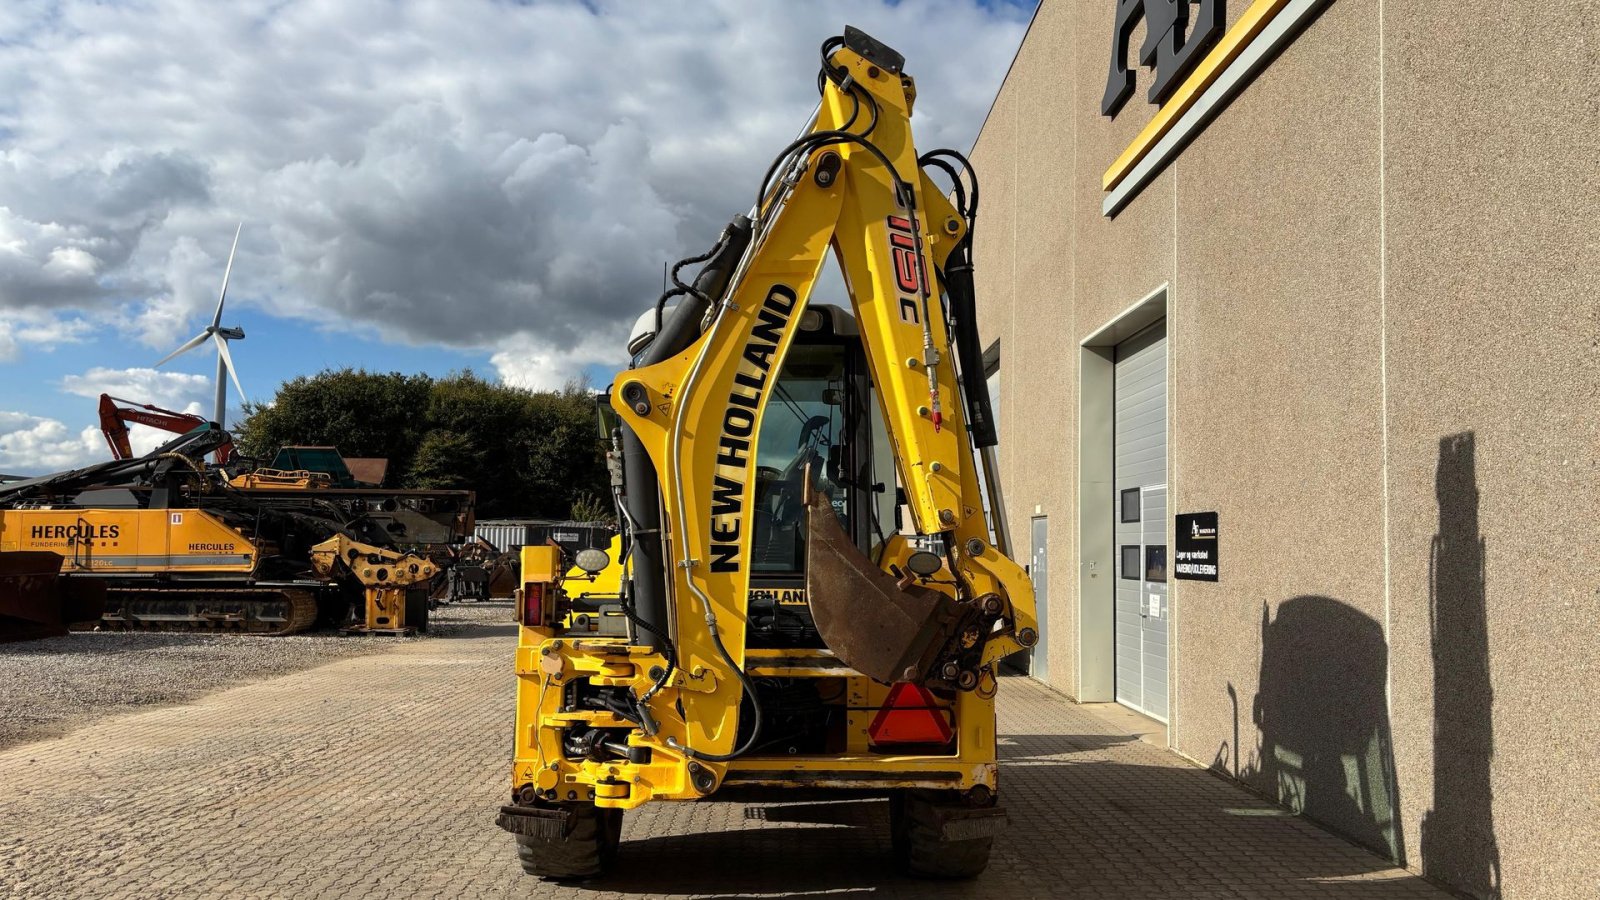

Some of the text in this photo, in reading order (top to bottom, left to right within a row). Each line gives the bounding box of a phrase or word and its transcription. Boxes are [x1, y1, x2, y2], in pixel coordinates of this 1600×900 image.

[136, 415, 169, 427] HITACHI
[710, 284, 798, 573] NEW HOLLAND
[31, 525, 119, 538] HERCULES
[188, 543, 235, 551] HERCULES
